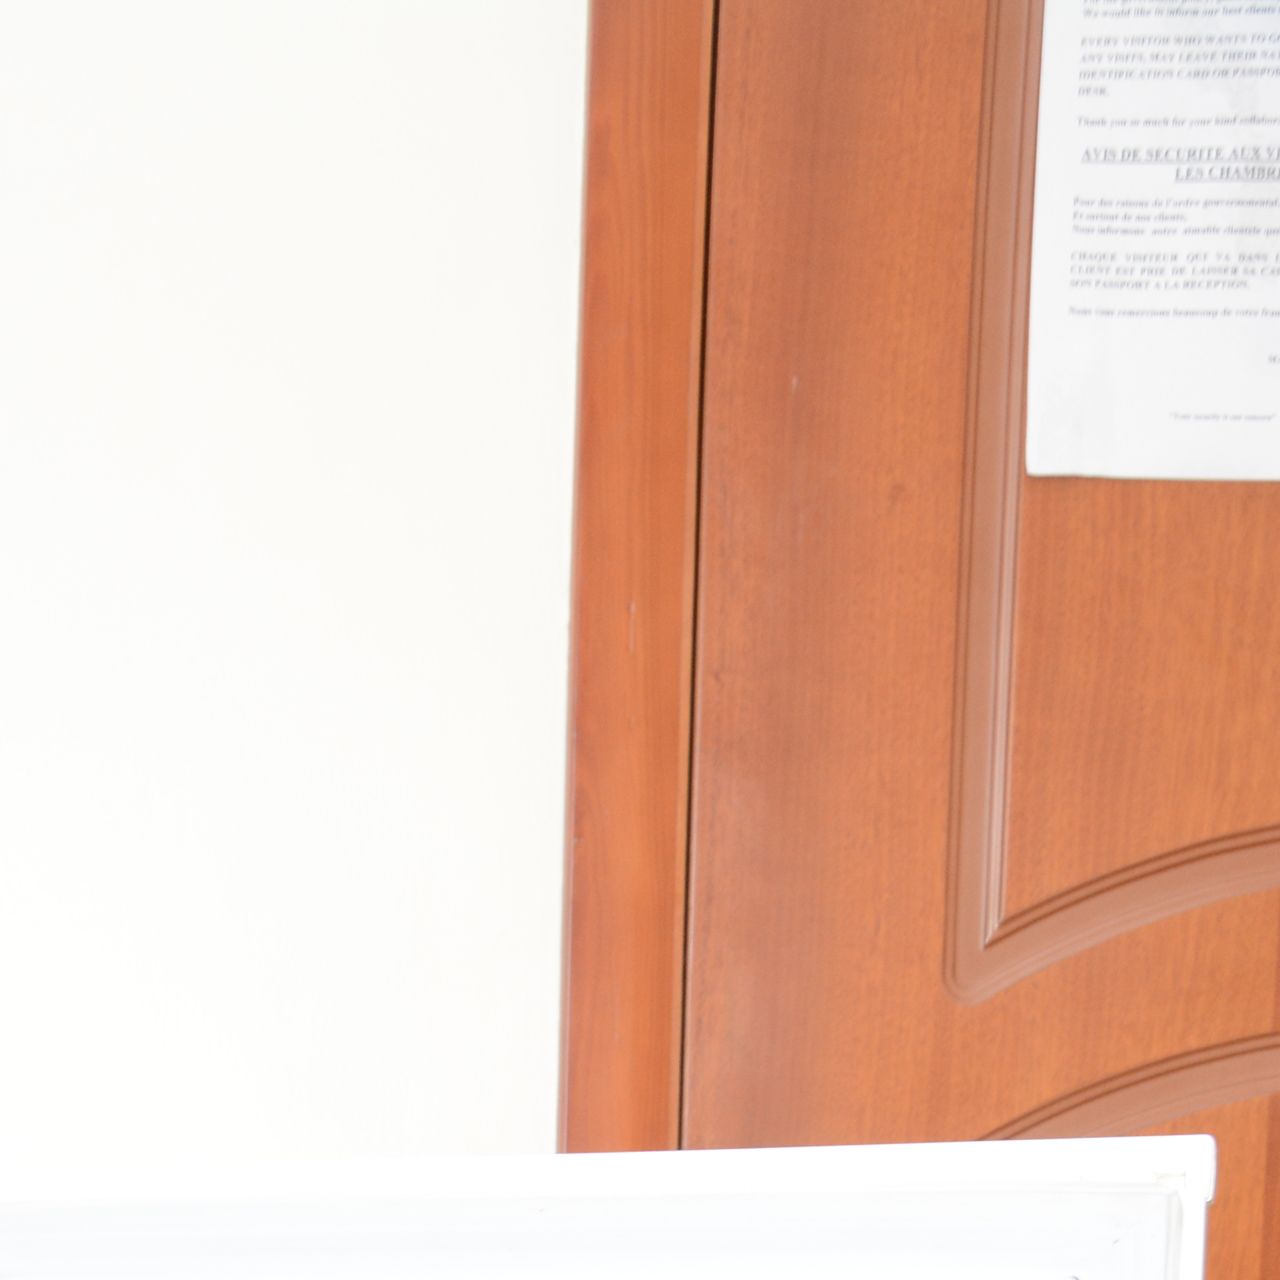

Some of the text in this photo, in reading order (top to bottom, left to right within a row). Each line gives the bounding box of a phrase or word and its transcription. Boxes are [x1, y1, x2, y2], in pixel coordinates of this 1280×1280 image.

[1080, 146, 1116, 163] AVIS
[1120, 146, 1140, 163] DE
[1144, 146, 1223, 163] SECURITE
[1228, 146, 1261, 163] AUX
